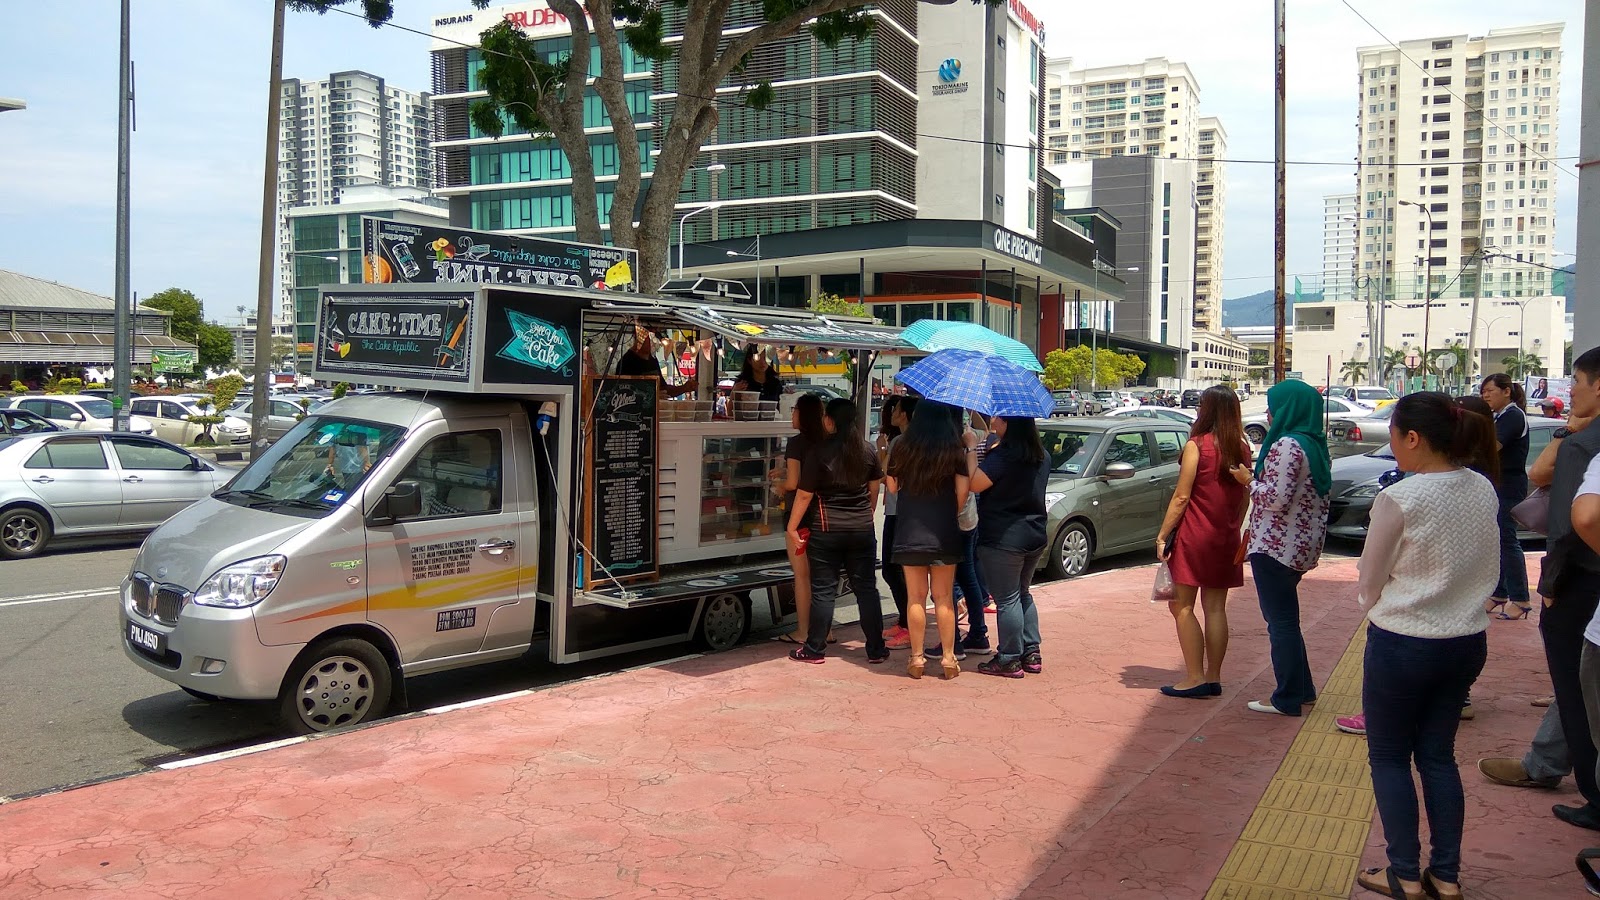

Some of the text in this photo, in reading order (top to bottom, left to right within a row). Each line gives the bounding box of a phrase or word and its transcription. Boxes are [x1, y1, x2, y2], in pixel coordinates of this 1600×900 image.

[435, 14, 473, 27] INSURANS
[505, 7, 567, 29] PRUDEN
[994, 228, 1042, 265] ONE PRECINCT
[537, 254, 562, 268] Cake
[563, 257, 581, 270] The
[361, 339, 374, 350] The
[375, 339, 392, 351] Cake
[528, 340, 562, 367] Cake
